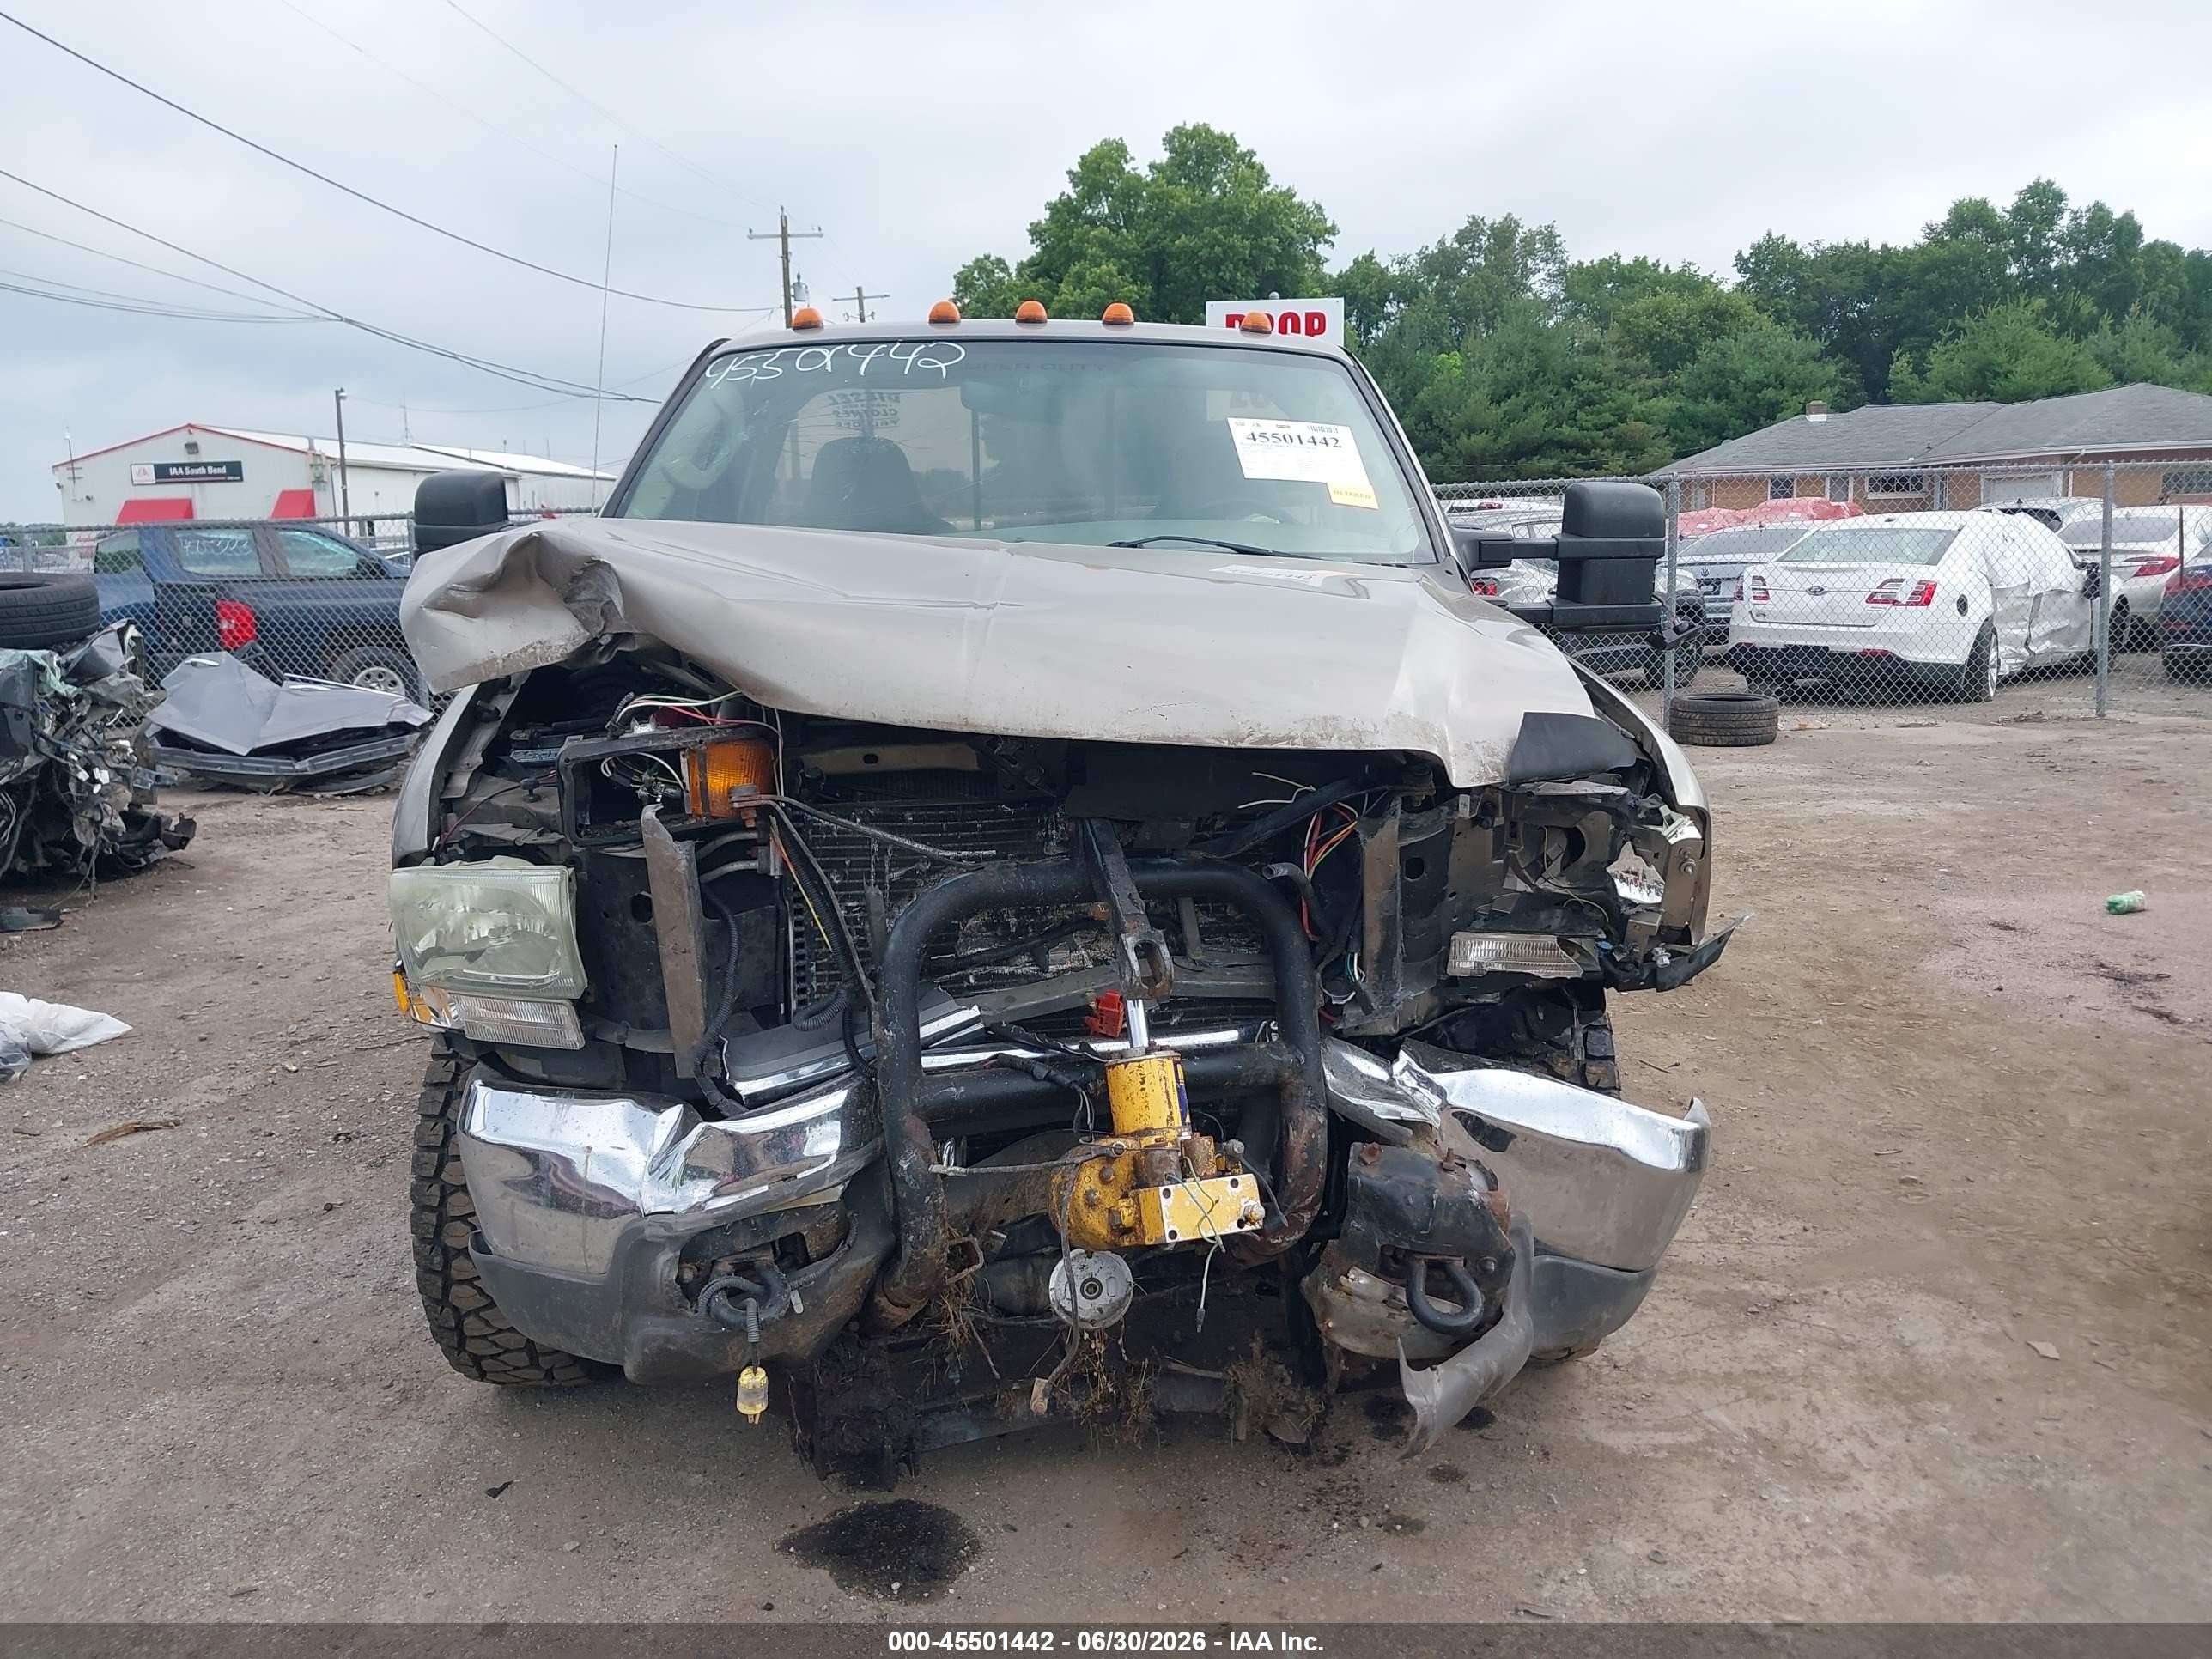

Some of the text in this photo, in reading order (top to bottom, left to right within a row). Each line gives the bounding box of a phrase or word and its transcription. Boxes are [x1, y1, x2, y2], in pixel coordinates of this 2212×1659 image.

[1225, 312, 1326, 337] DOP
[1246, 431, 1342, 448] 45501442
[169, 465, 227, 476] IAA South Bend
